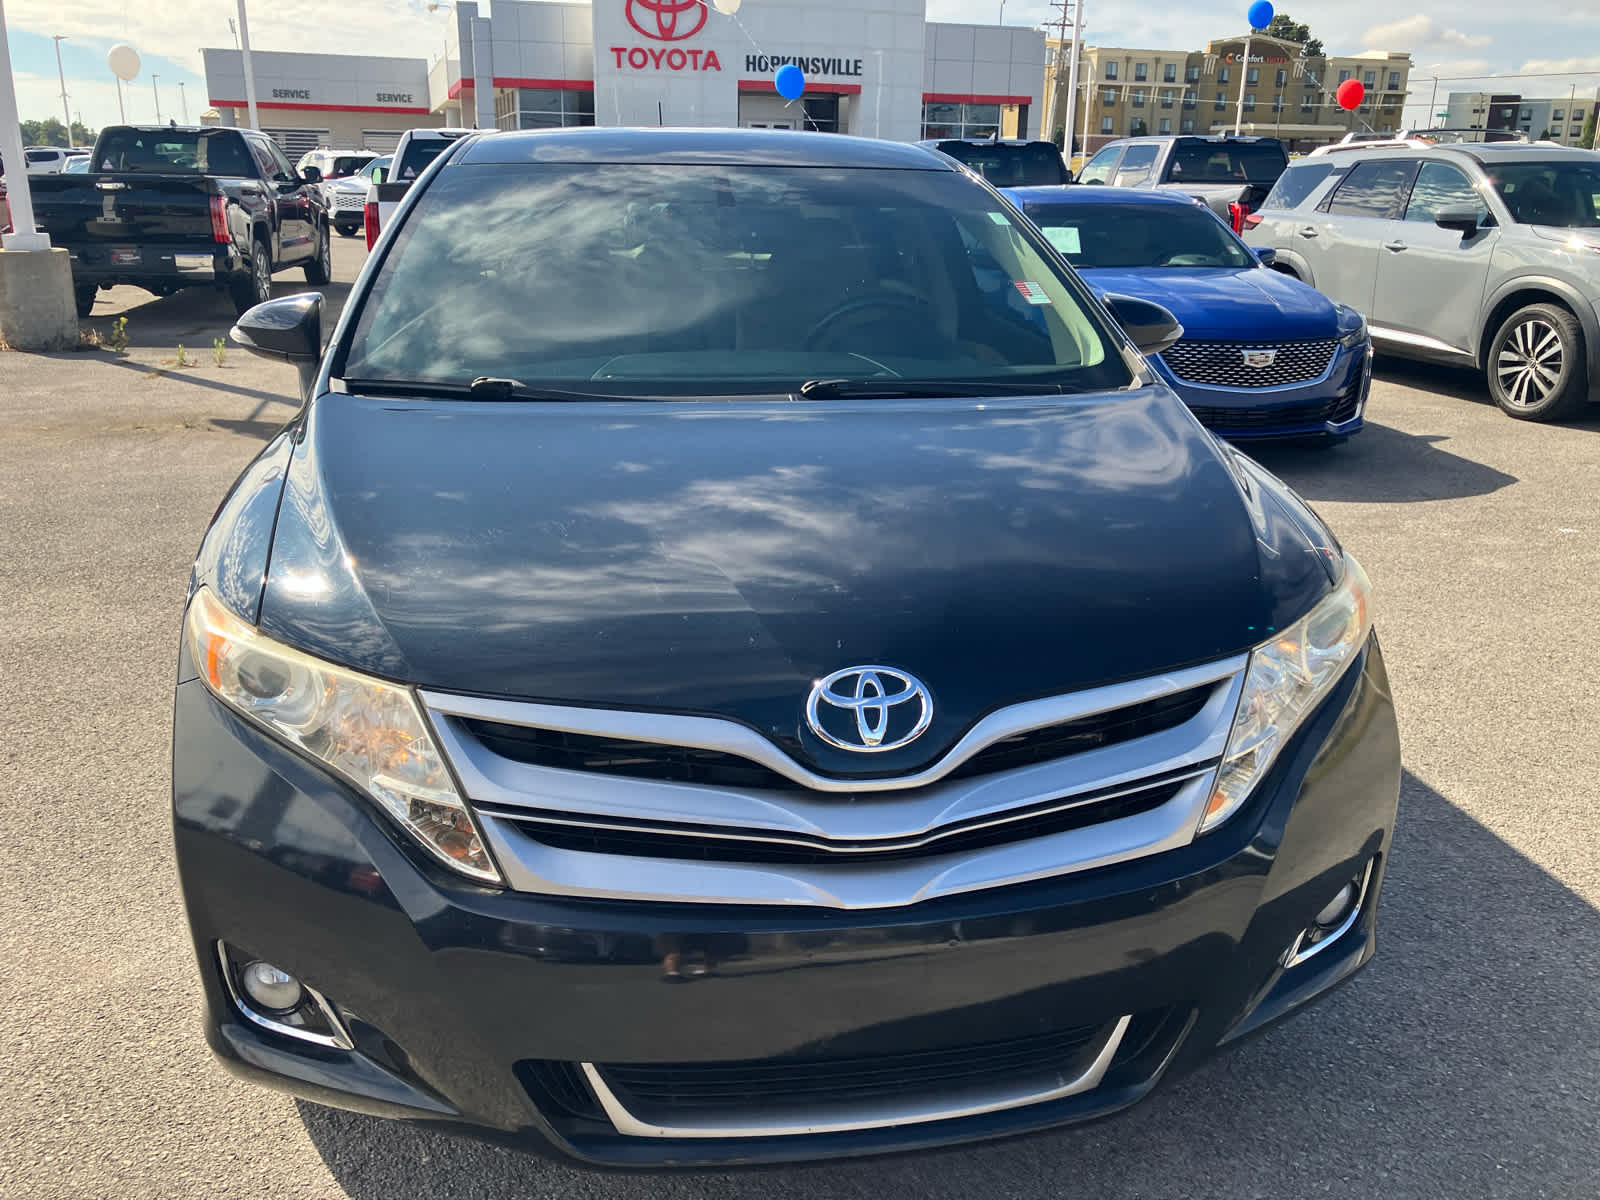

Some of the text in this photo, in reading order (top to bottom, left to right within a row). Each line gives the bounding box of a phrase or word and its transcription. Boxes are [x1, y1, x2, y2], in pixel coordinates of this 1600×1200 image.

[610, 47, 722, 71] TOYOTA
[272, 88, 311, 99] SERVICE
[376, 93, 413, 103] SERVICE
